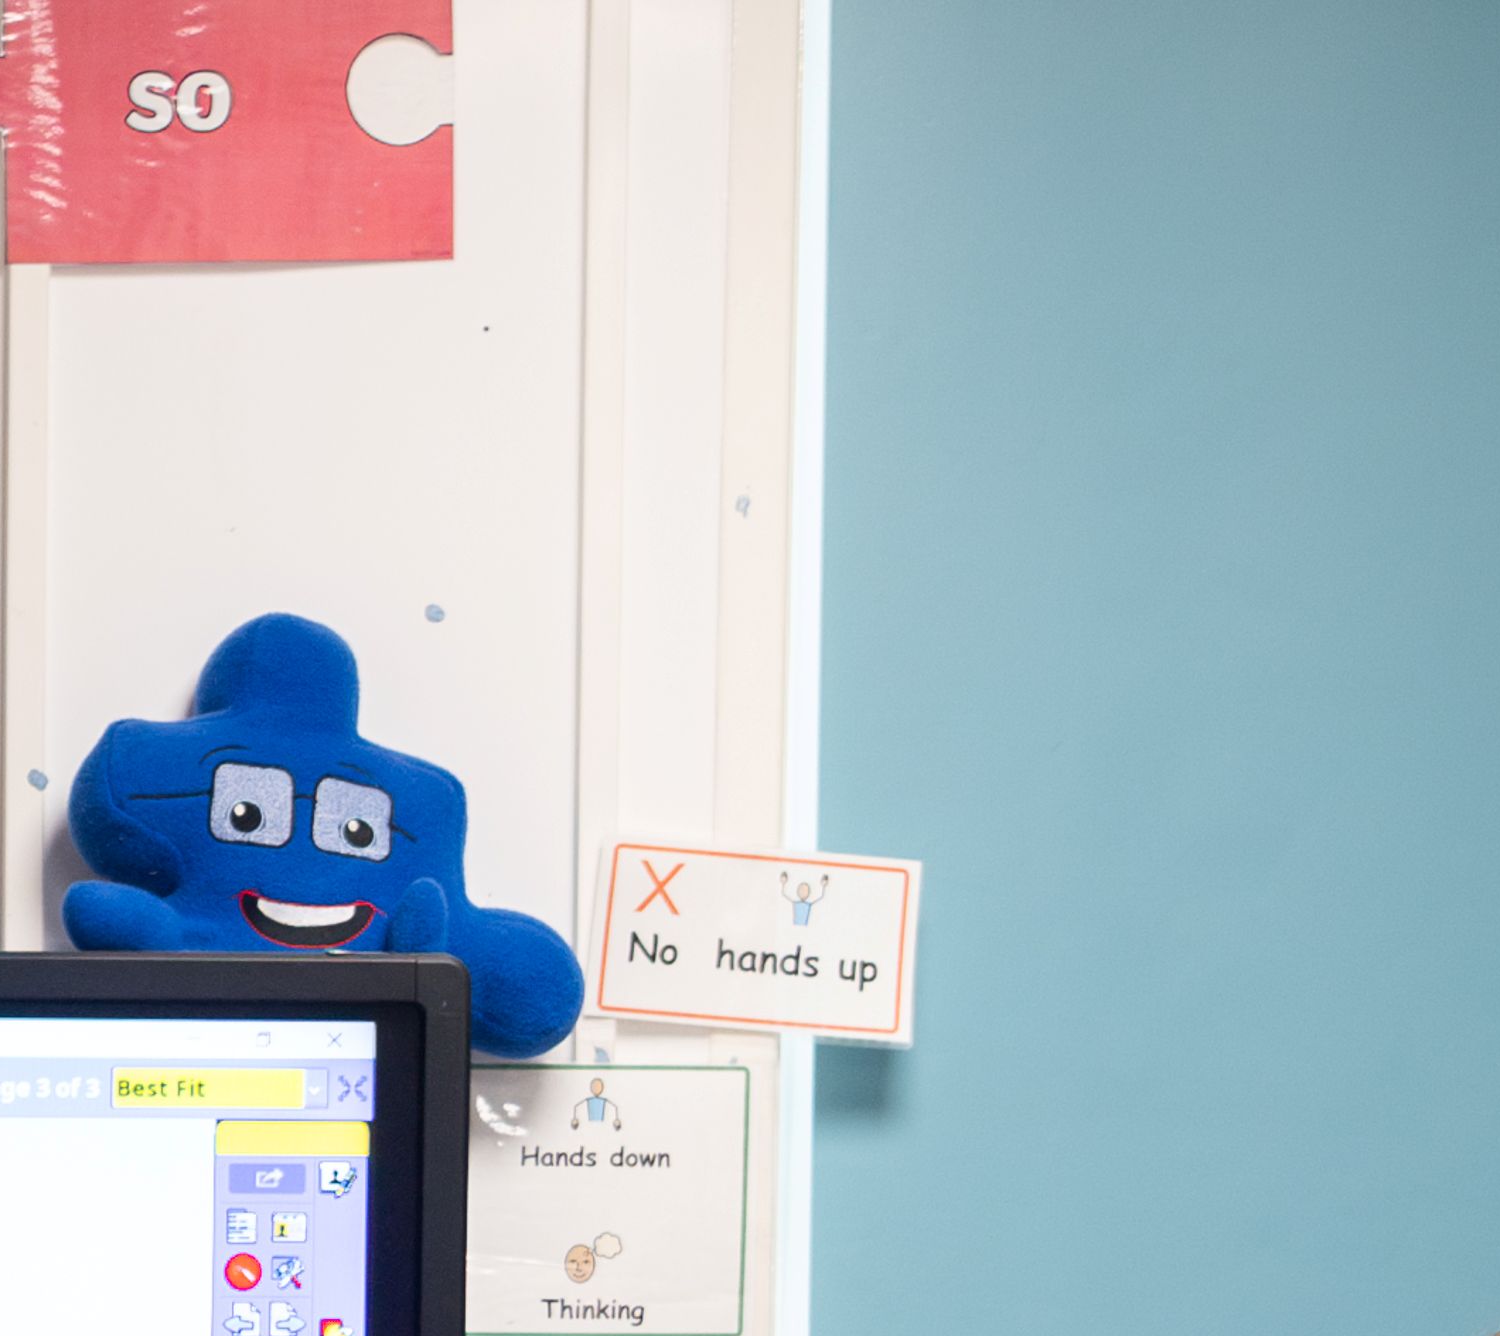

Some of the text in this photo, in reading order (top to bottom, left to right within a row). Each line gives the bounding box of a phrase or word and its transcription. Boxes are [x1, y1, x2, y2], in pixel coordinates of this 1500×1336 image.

[124, 69, 234, 134] so
[628, 931, 879, 992] No hands up
[34, 1077, 52, 1098] 3
[55, 1076, 83, 1098] of
[84, 1077, 101, 1098] 3
[117, 1078, 206, 1099] Best Fit
[521, 1145, 671, 1169] Hands down
[541, 1298, 645, 1326] Thinking
